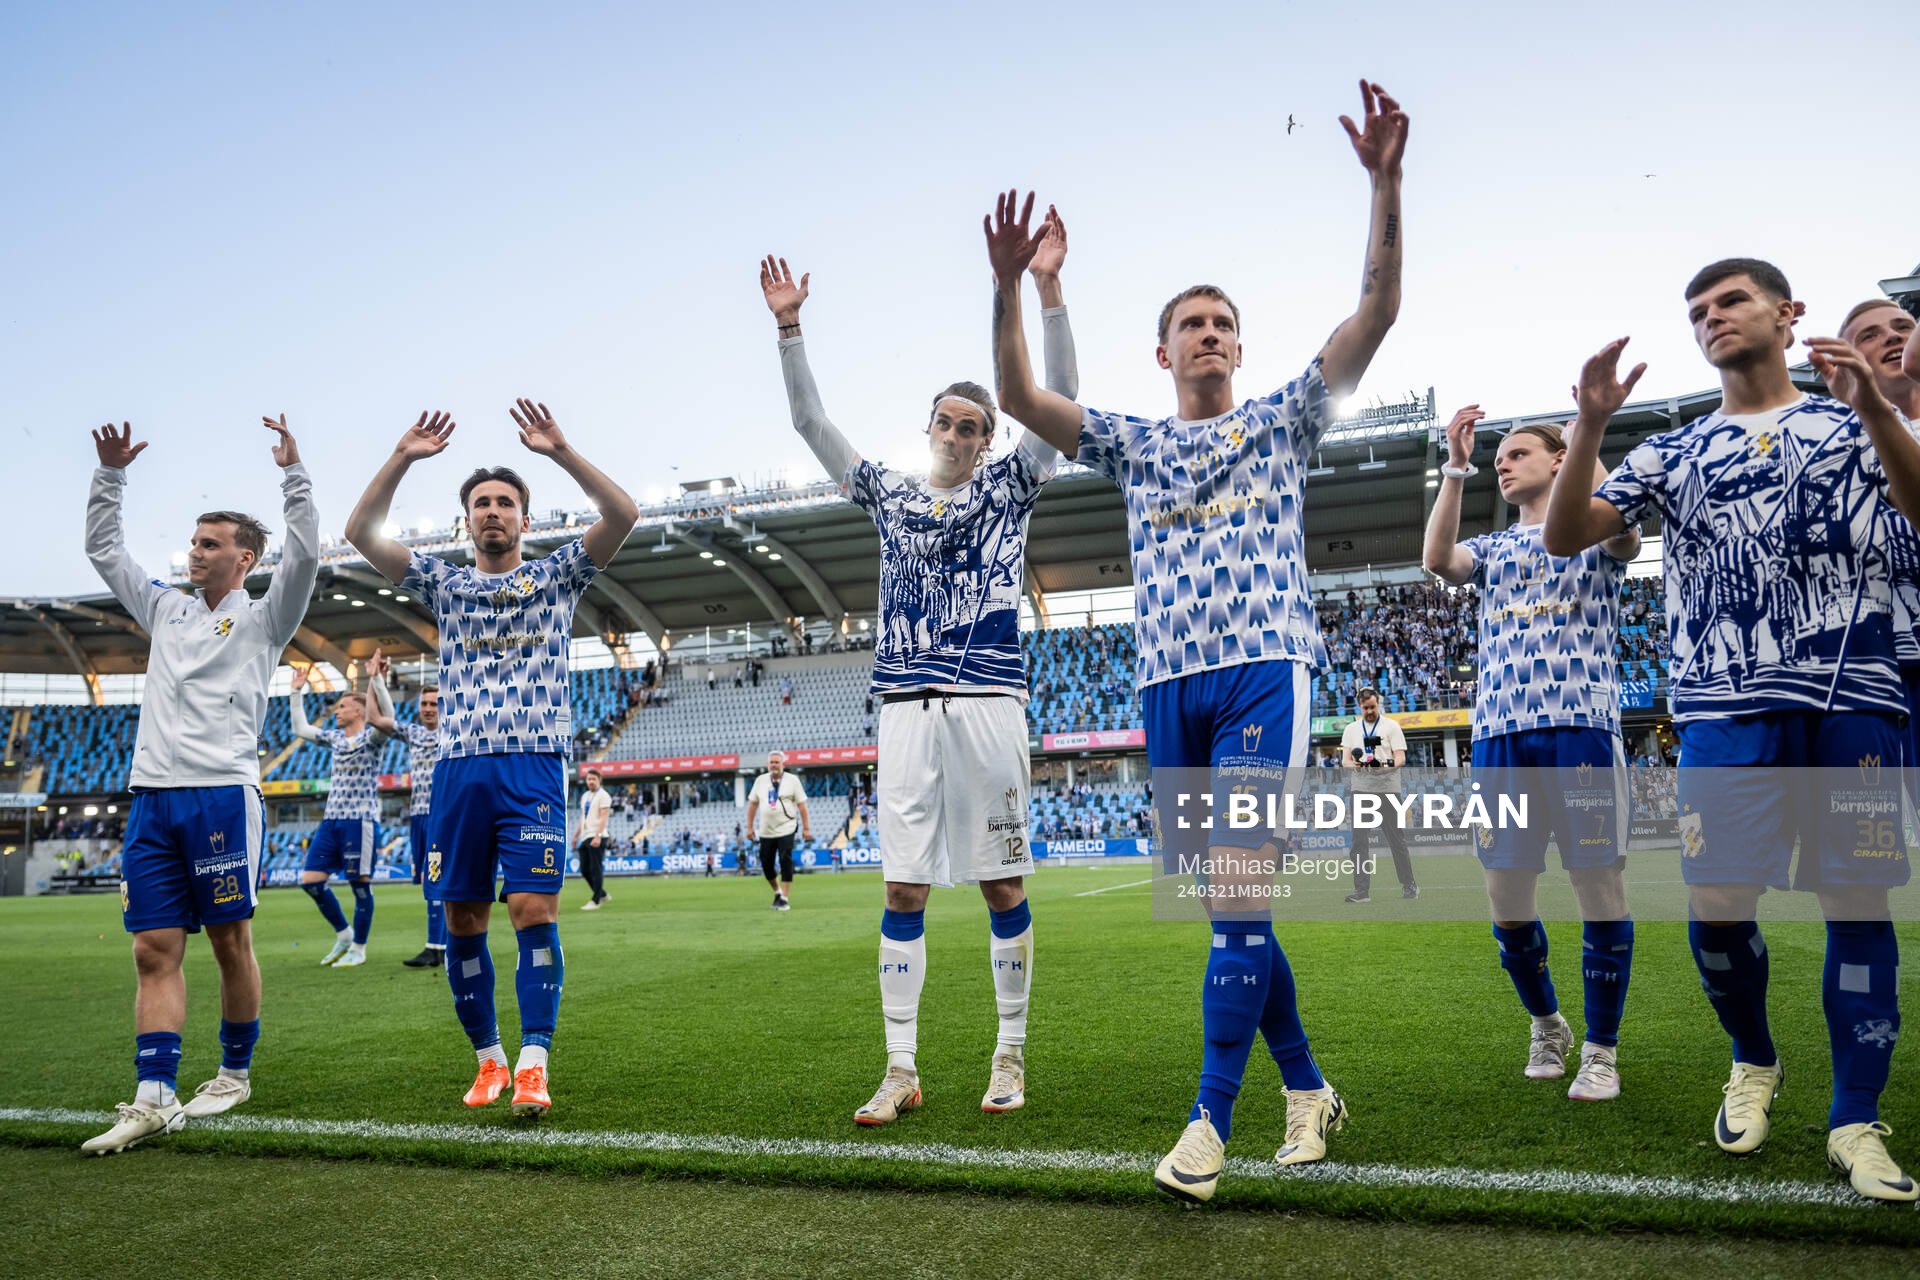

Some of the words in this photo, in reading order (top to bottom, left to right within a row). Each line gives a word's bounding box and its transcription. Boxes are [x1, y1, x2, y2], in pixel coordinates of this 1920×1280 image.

[1328, 540, 1354, 552] F3
[1631, 826, 1657, 835] Ullevi
[1856, 820, 1896, 848] 36
[1414, 834, 1442, 842] Gamla
[1443, 833, 1468, 841] Ullevi
[1005, 836, 1023, 857] 12
[1047, 840, 1105, 853] FAMECO
[543, 847, 555, 867] 6
[1853, 849, 1894, 859] CRAFT
[662, 854, 723, 869] SERNEE
[1001, 857, 1022, 866] CRAFT
[531, 867, 555, 875] CRAFT
[212, 874, 239, 898] 28
[214, 894, 238, 904] CRAFT
